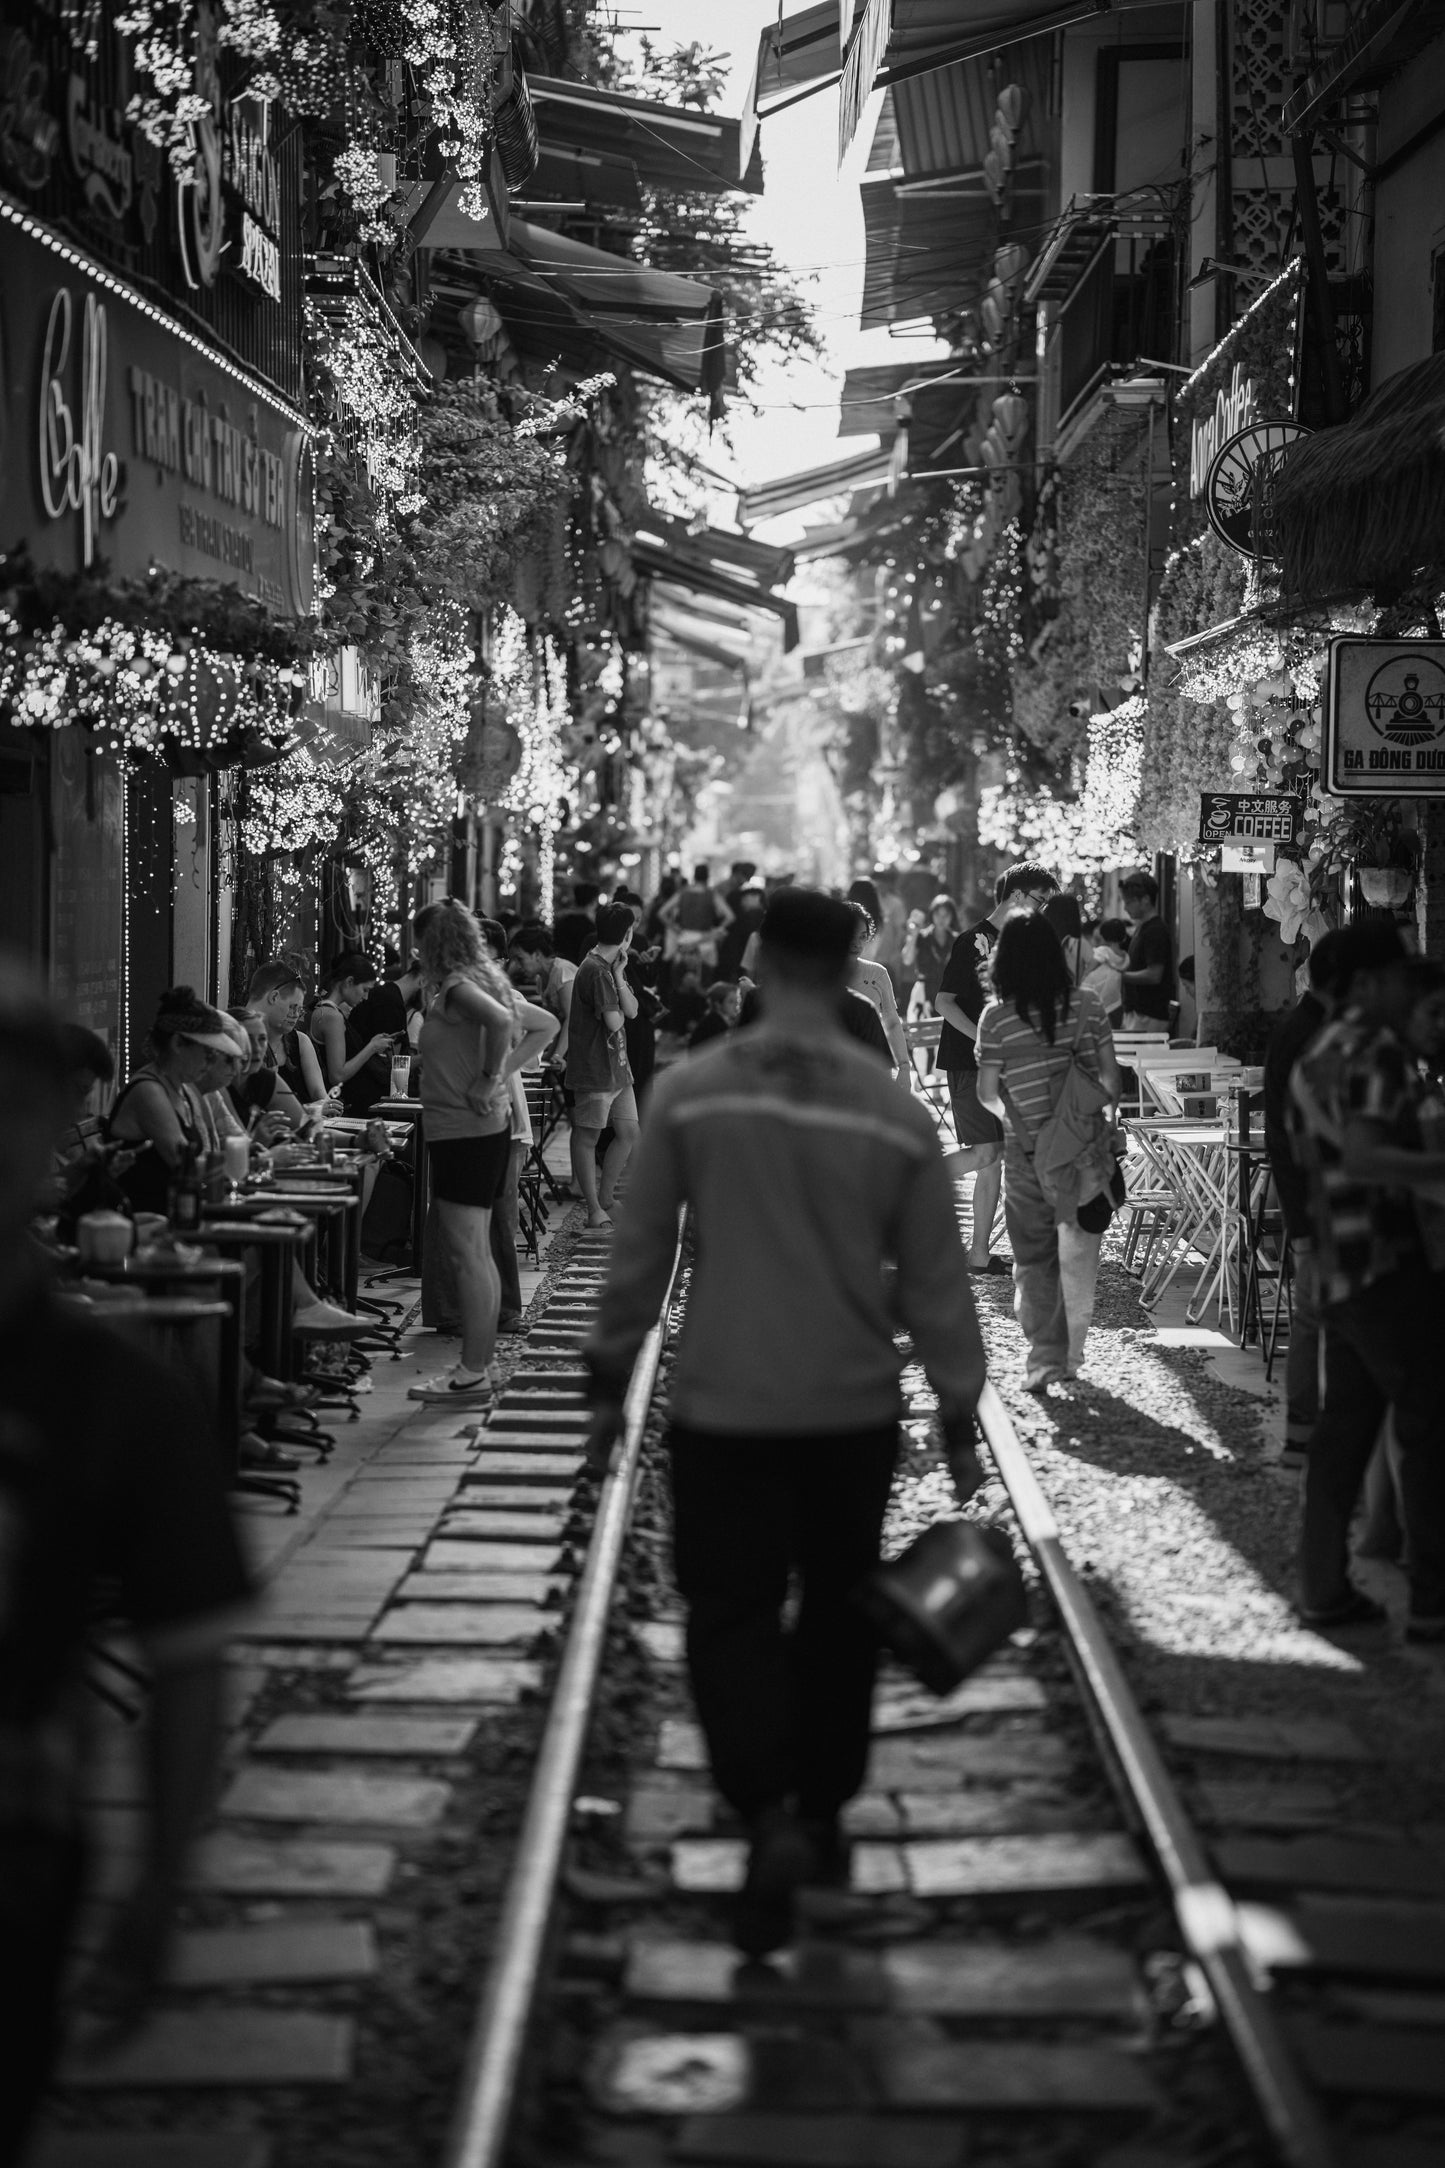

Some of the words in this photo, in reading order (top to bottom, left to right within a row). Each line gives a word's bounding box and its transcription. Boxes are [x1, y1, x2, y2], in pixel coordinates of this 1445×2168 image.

[260, 449, 286, 529] 13A
[1344, 750, 1364, 769] GA
[1369, 747, 1412, 769] ĐÔNG
[1238, 799, 1292, 814] 中文服务
[1205, 829, 1232, 838] OPEN
[1234, 816, 1291, 839] COFFEE
